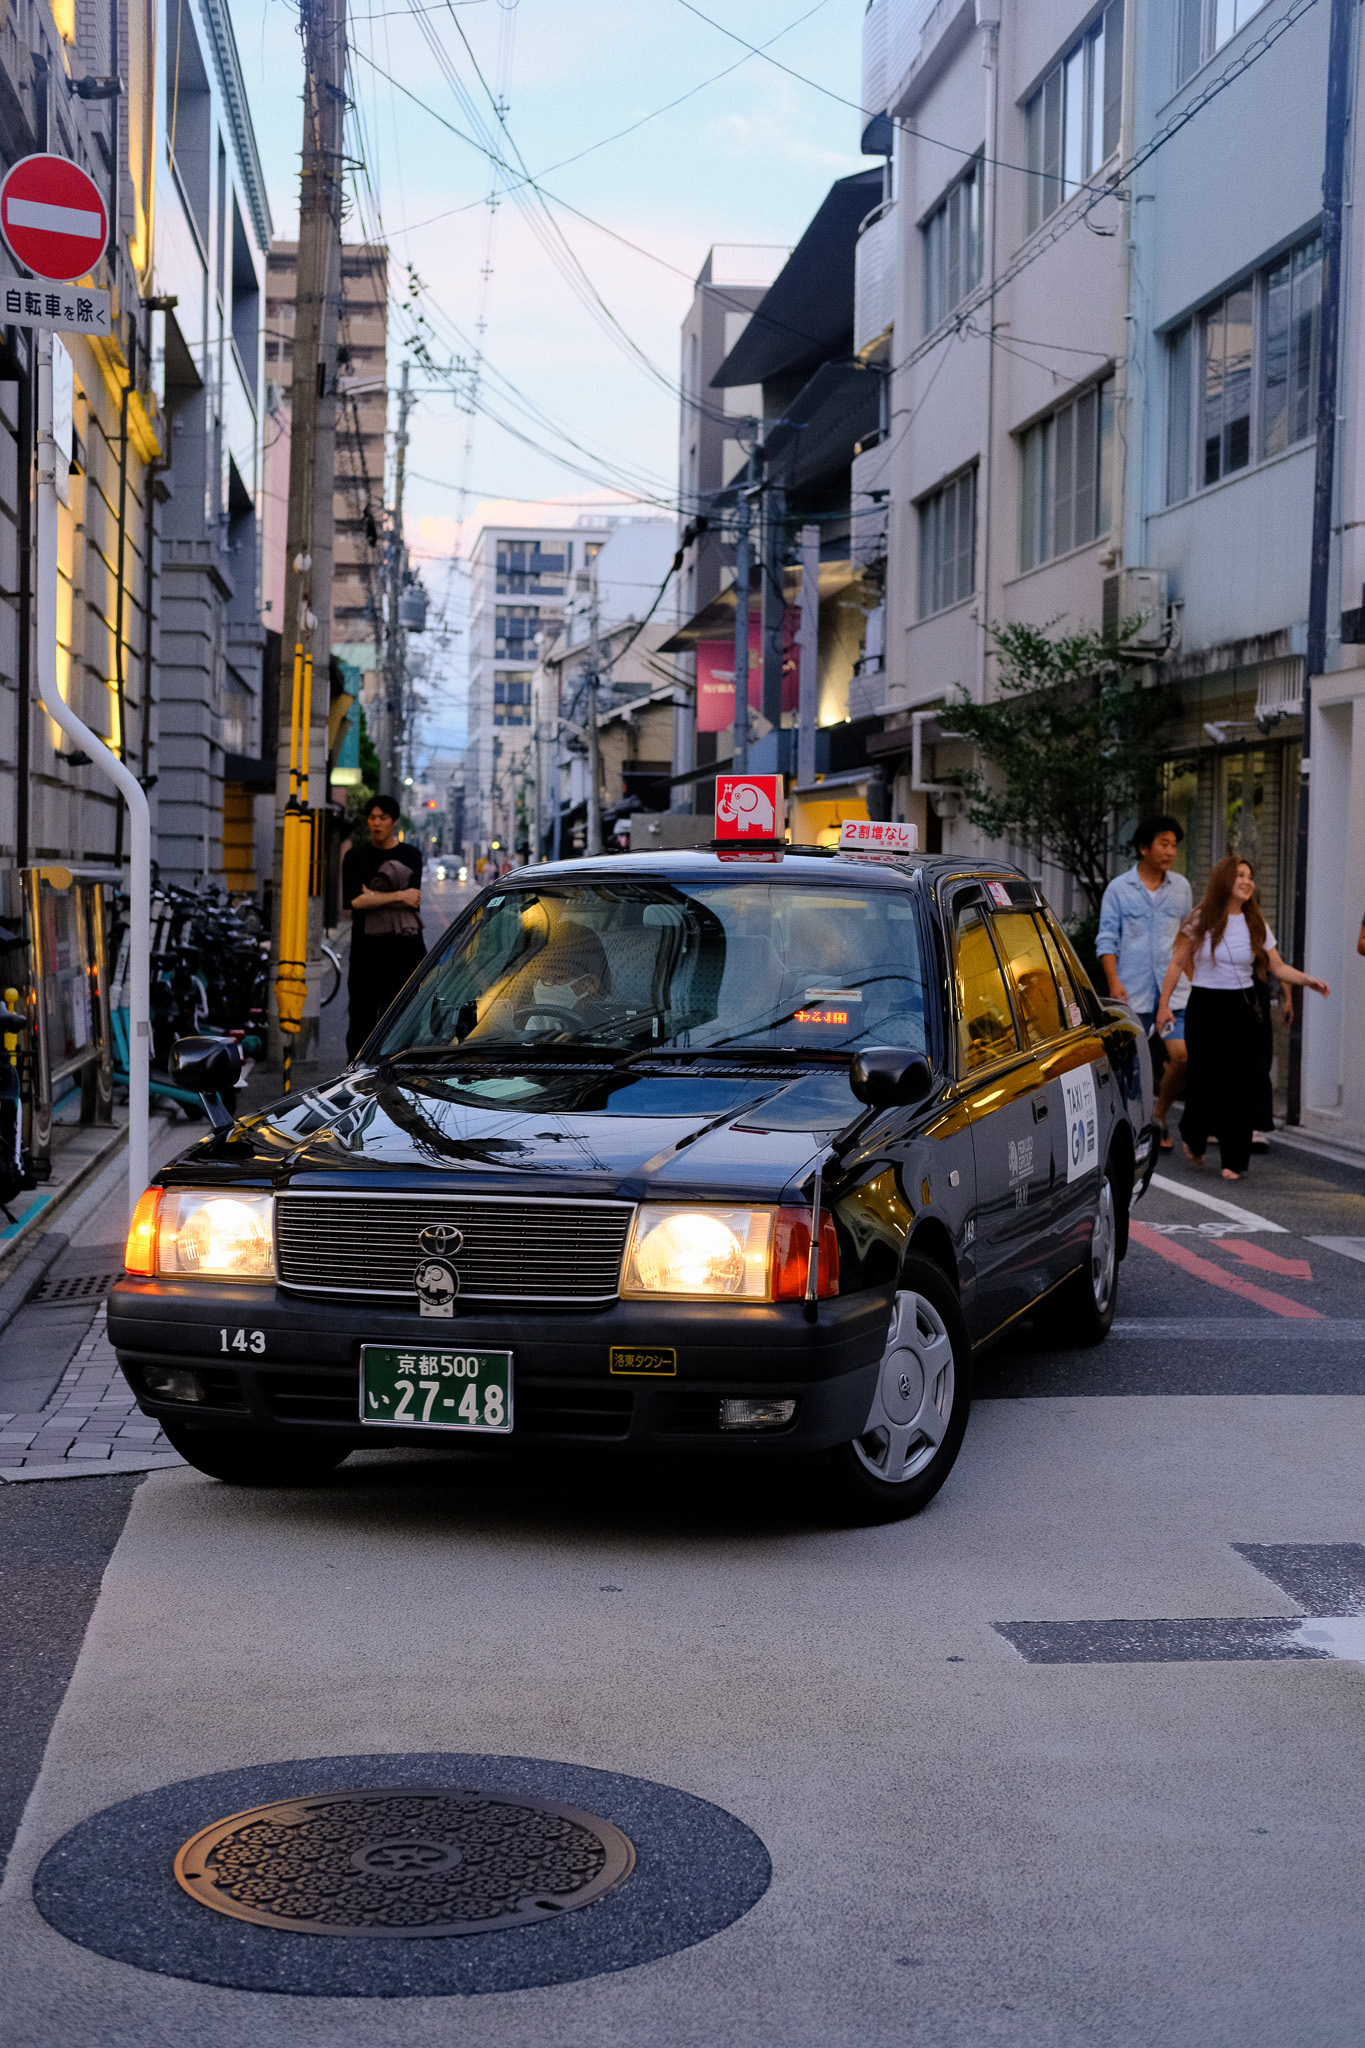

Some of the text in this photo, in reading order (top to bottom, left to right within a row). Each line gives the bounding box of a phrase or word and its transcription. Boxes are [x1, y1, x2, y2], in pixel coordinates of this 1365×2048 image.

[6, 288, 106, 325] 自転車を除く
[845, 824, 909, 841] 2割増なし
[1067, 1084, 1083, 1116] TAXI
[1072, 1119, 1085, 1166] GO
[1015, 1183, 1028, 1210] TAXI
[220, 1329, 266, 1354] 143
[614, 1353, 672, 1369] 洛東タクシー
[368, 1379, 505, 1426] い 27-48
